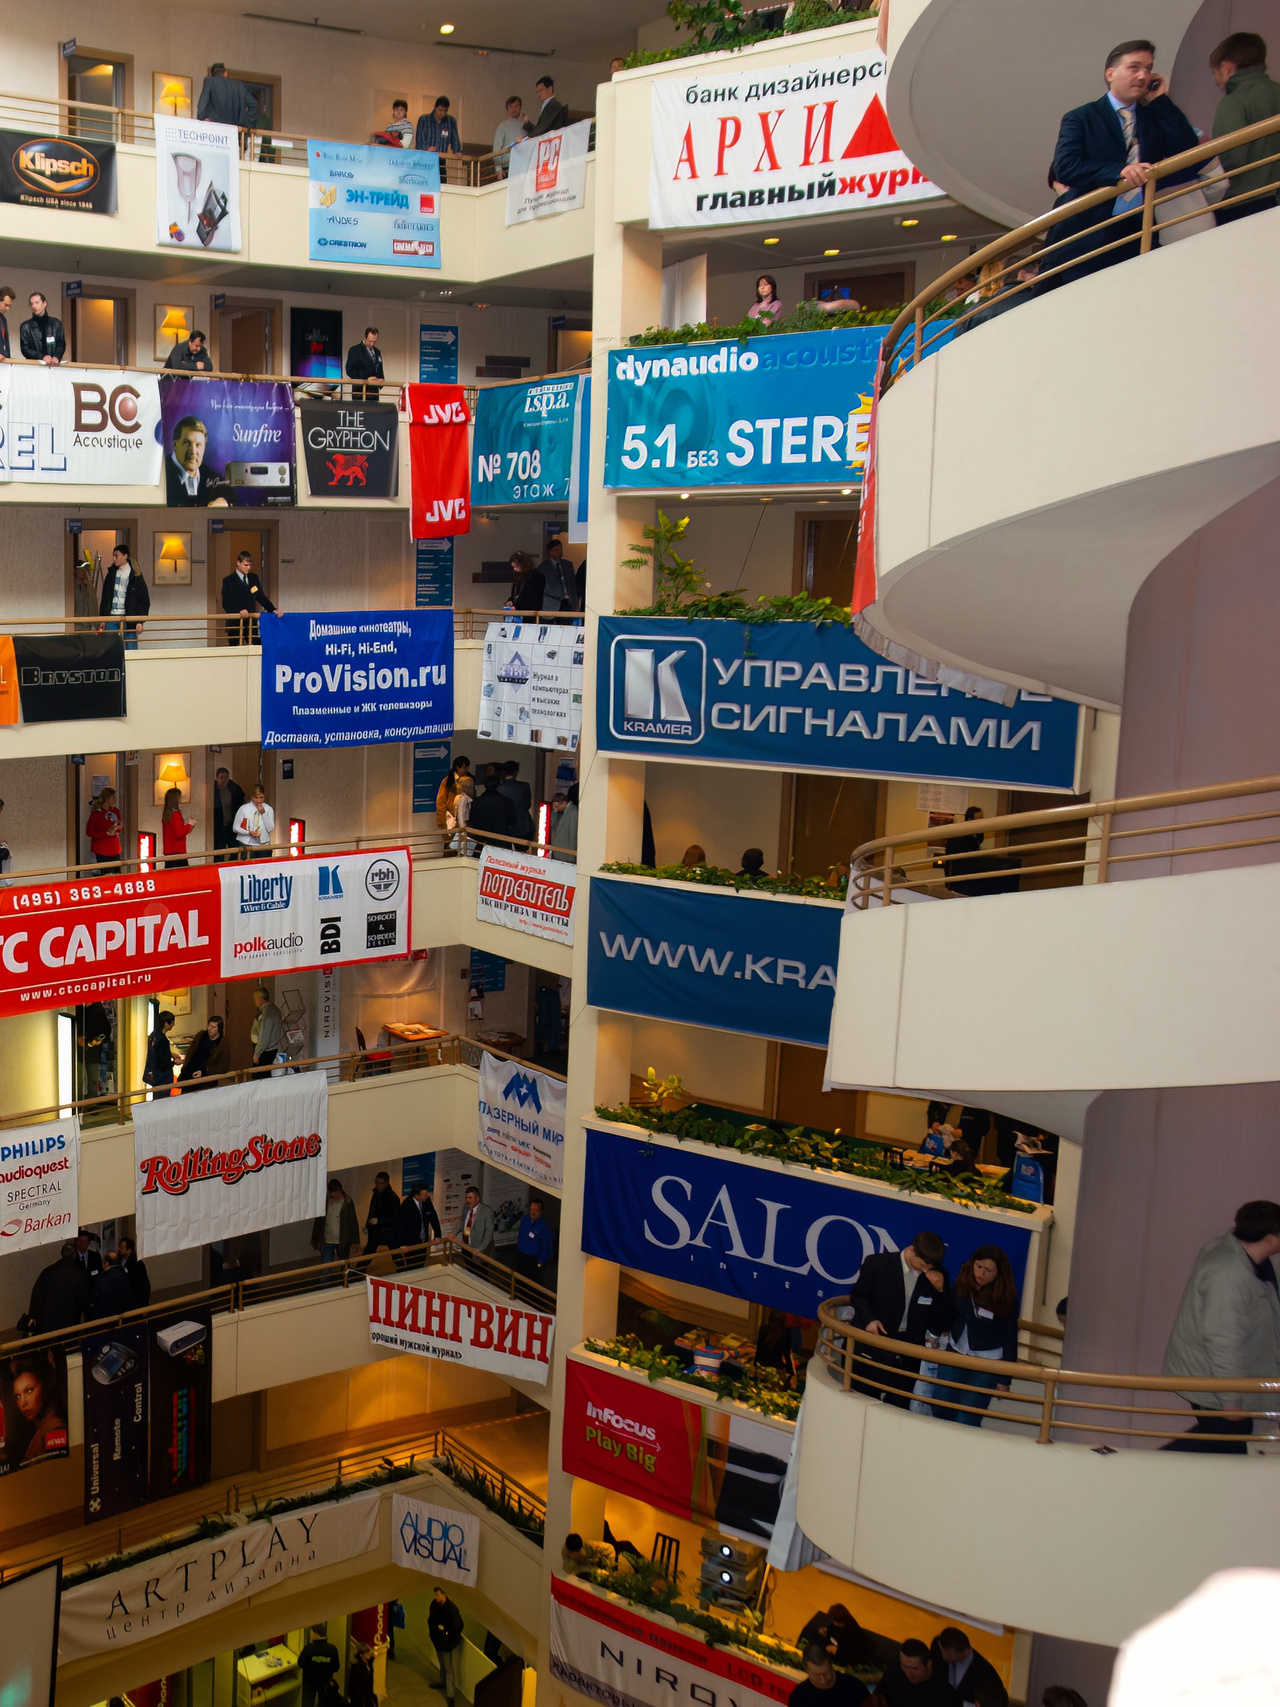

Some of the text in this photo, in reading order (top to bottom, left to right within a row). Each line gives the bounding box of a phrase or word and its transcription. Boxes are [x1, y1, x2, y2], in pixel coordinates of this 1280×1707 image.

[686, 84, 739, 105] банк
[178, 129, 229, 145] TECHPOINT
[19, 150, 94, 178] Klipsch
[346, 189, 409, 210] ЭН-ТРЕЙД
[616, 346, 758, 387] dynaudio
[72, 381, 142, 434] BC
[338, 410, 365, 427] THE
[423, 401, 466, 424] JVC
[72, 432, 143, 452] Acoustique
[233, 423, 282, 447] Sunfire
[308, 427, 390, 451] GRYPHON
[621, 423, 677, 470] 5.1
[687, 450, 719, 468] БЕЗ
[507, 449, 542, 481] 708
[512, 482, 554, 499] этаж
[425, 498, 466, 523] JVC
[309, 620, 412, 640] Домашние кинотеатры,
[325, 641, 397, 657] Hi-Fi, Hi-End,
[275, 663, 447, 693] ProVision.ru
[293, 699, 433, 716] Плазменные и ЖК телевизоры
[265, 721, 453, 746] Доставка, установка, консультации
[623, 719, 693, 736] KRAMER
[710, 702, 1043, 752] СИГНАЛАМИ
[485, 855, 546, 876] Полезный журнал
[13, 880, 156, 910] (495) 363-4888
[240, 873, 293, 903] Liberty
[483, 872, 569, 911] ПОТРЕБИТЕЛЬ
[243, 901, 286, 911] Wire Cable
[481, 897, 569, 927] ЭКСПЕРТИЗА ТЕСТЫ
[39, 910, 209, 968] CAPITAL
[234, 932, 303, 959] polkaudio
[320, 916, 341, 955] BDI
[20, 974, 152, 1002] www.ctccapital.ru
[0, 1134, 66, 1161] PHILIPS
[542, 1127, 564, 1146] МИР
[7, 1181, 62, 1203] SPECTRAL
[18, 1198, 51, 1212] Germany
[23, 1212, 71, 1234] Barkan
[370, 1278, 553, 1364] ПИНГВИН
[134, 1382, 143, 1423] Control
[586, 1401, 656, 1441] InFocus
[585, 1426, 656, 1474] Play Big
[91, 1443, 99, 1495] Universal
[401, 1511, 464, 1547] AUDIO
[400, 1529, 470, 1572] VISUAL
[106, 1512, 320, 1620] ARTPLAY
[105, 1548, 317, 1640] центр дизайна
